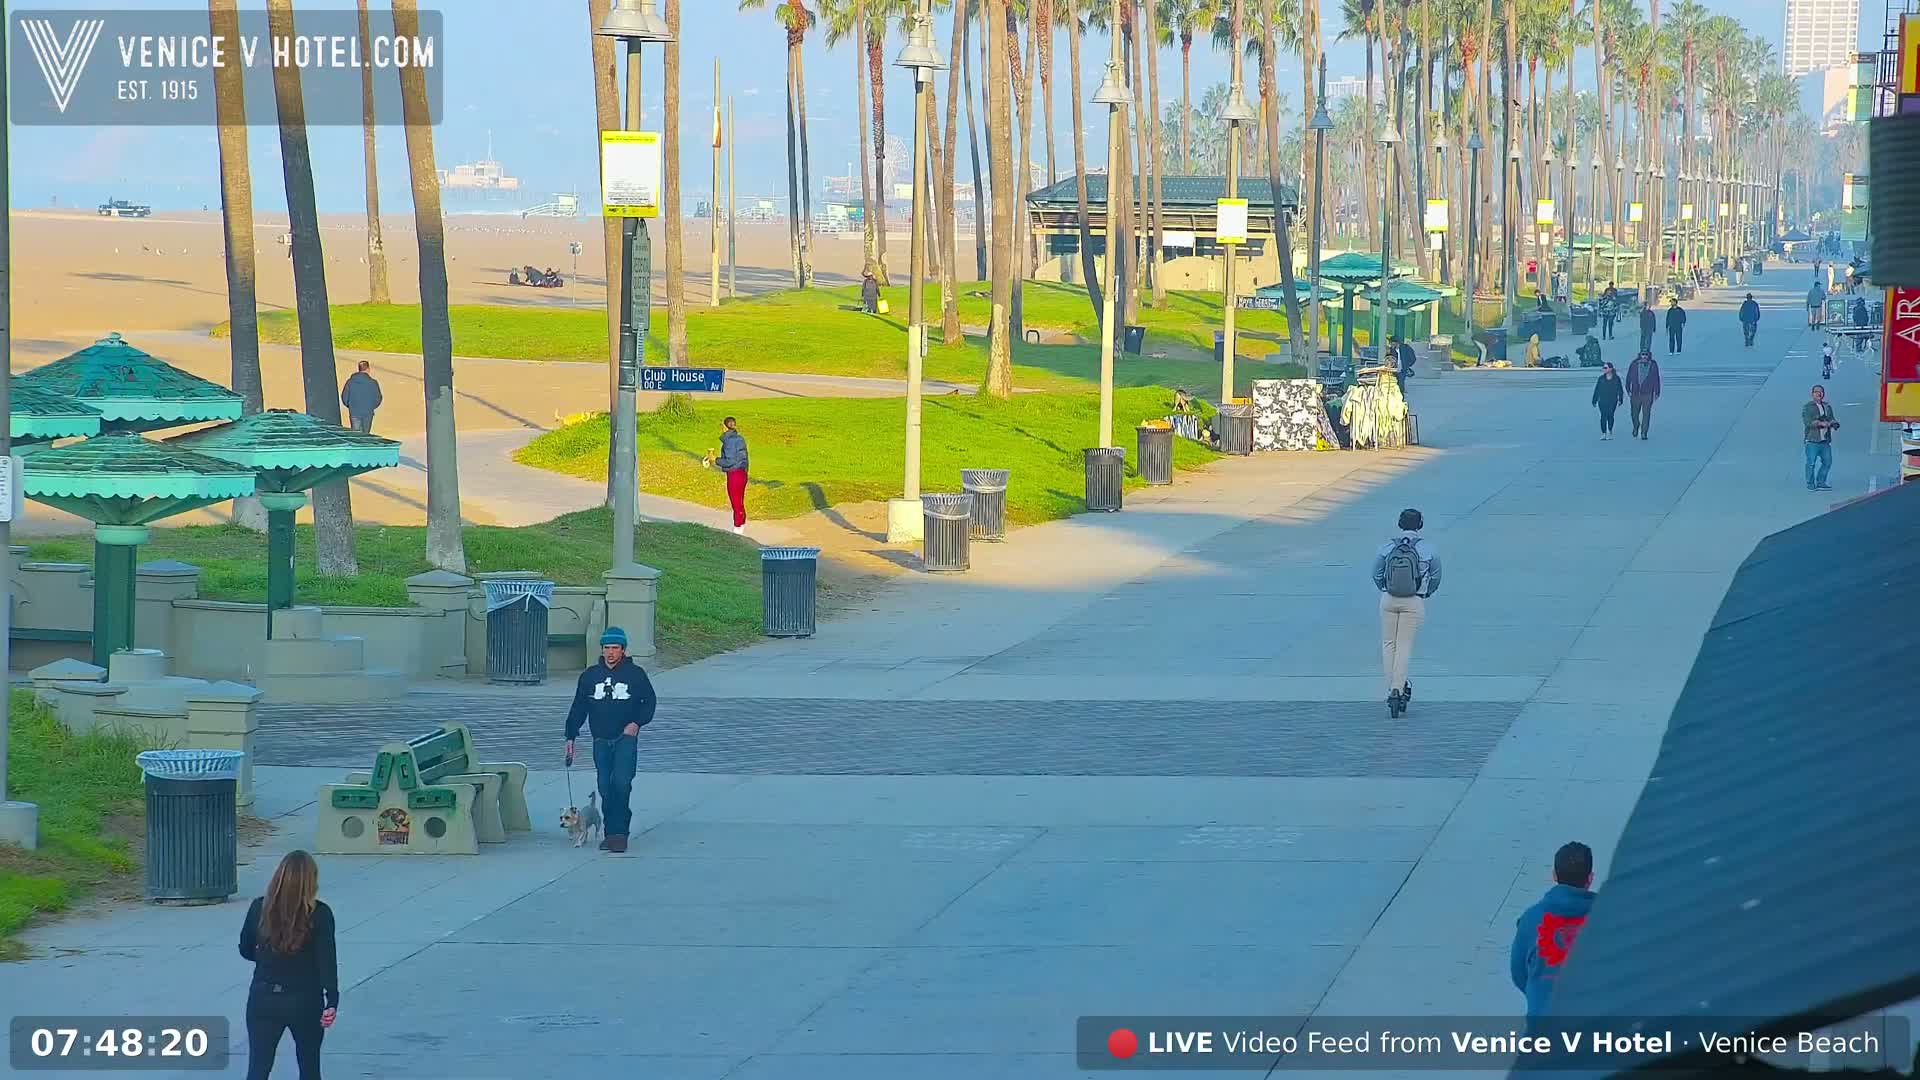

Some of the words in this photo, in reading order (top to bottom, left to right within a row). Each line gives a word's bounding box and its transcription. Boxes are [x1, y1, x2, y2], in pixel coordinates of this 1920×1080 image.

[644, 369, 666, 381] Club
[671, 370, 704, 382] House
[657, 381, 662, 389] E
[710, 382, 719, 391] Av
